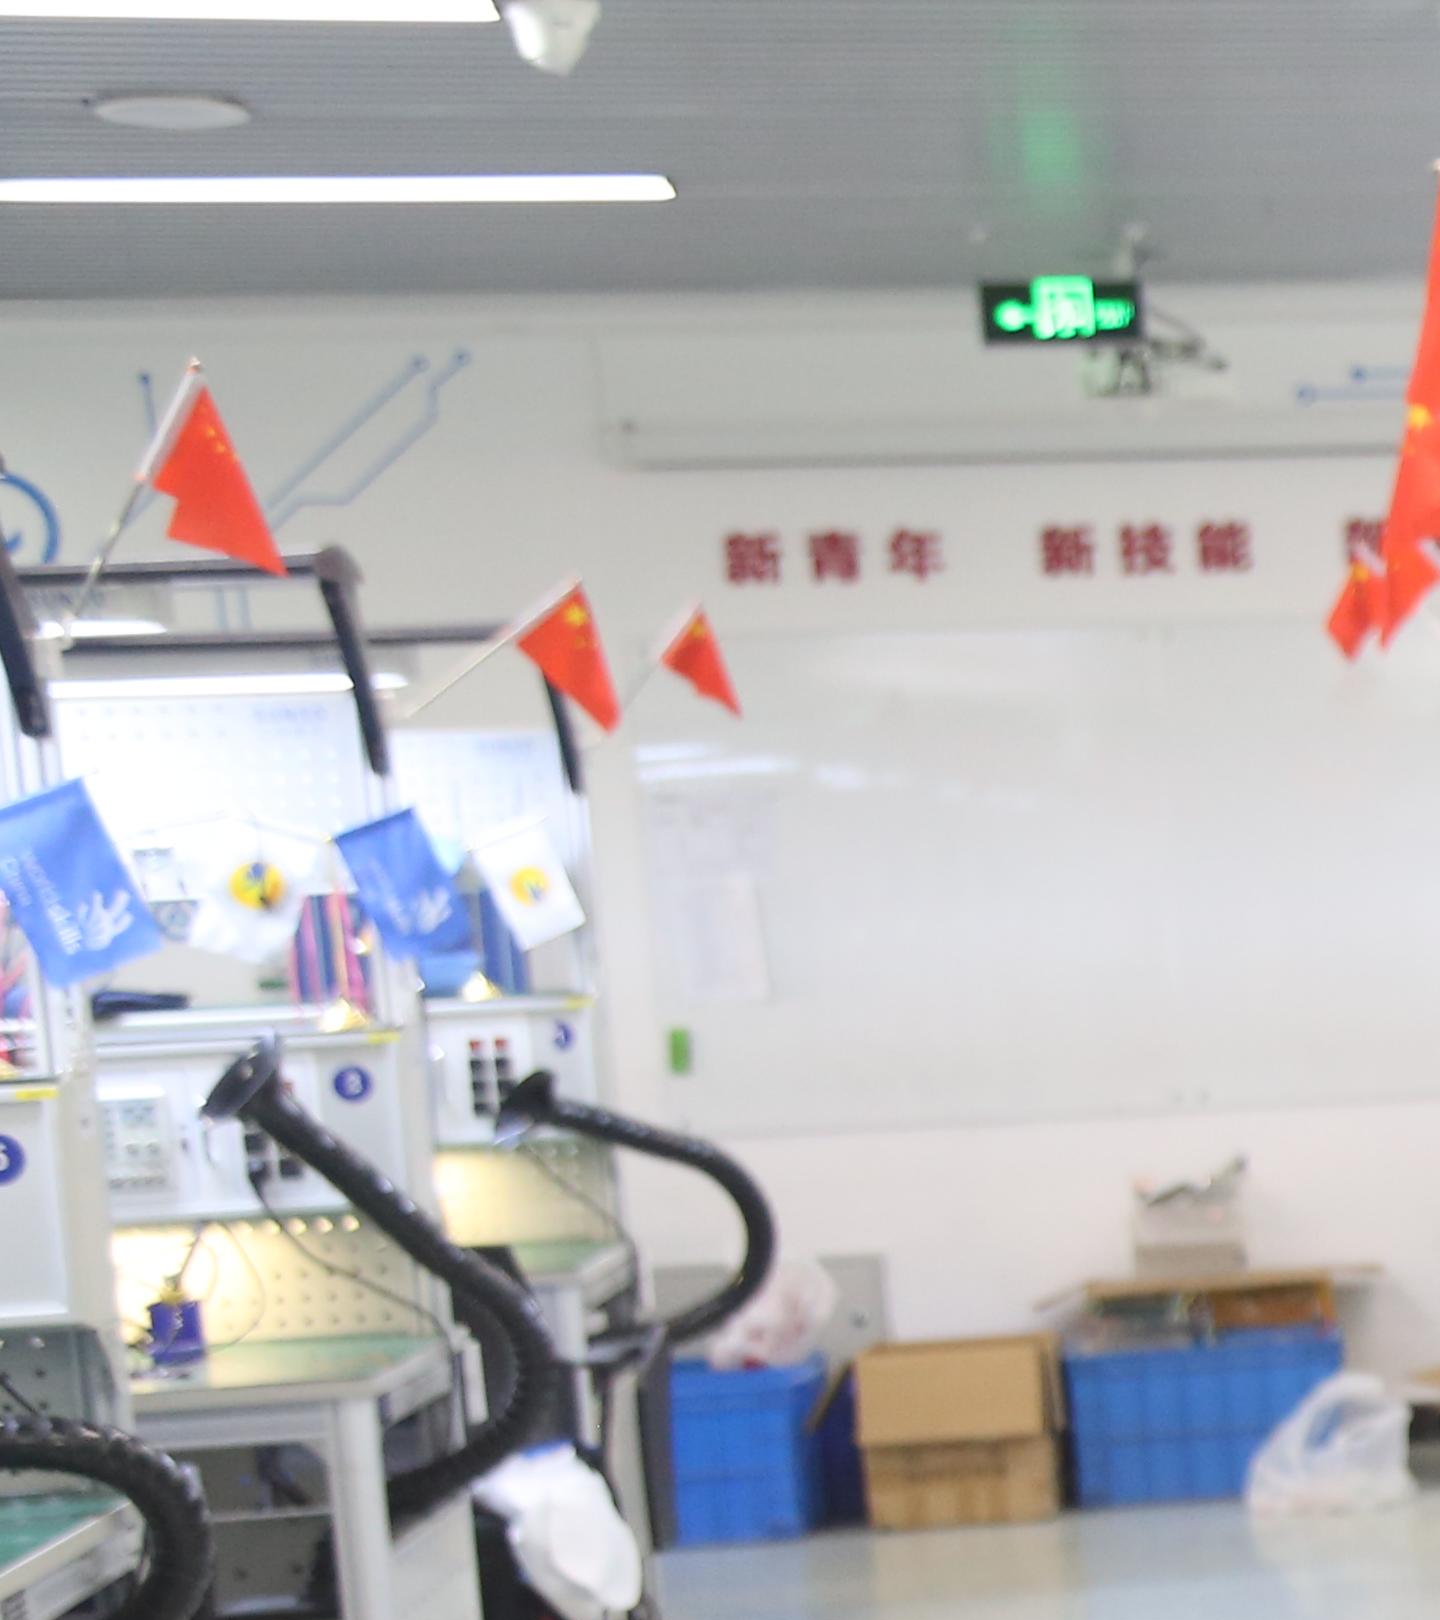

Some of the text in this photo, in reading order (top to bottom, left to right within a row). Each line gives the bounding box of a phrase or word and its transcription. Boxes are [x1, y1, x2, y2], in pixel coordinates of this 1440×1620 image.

[725, 530, 946, 585] 新青年
[1041, 521, 1254, 576] 新技能
